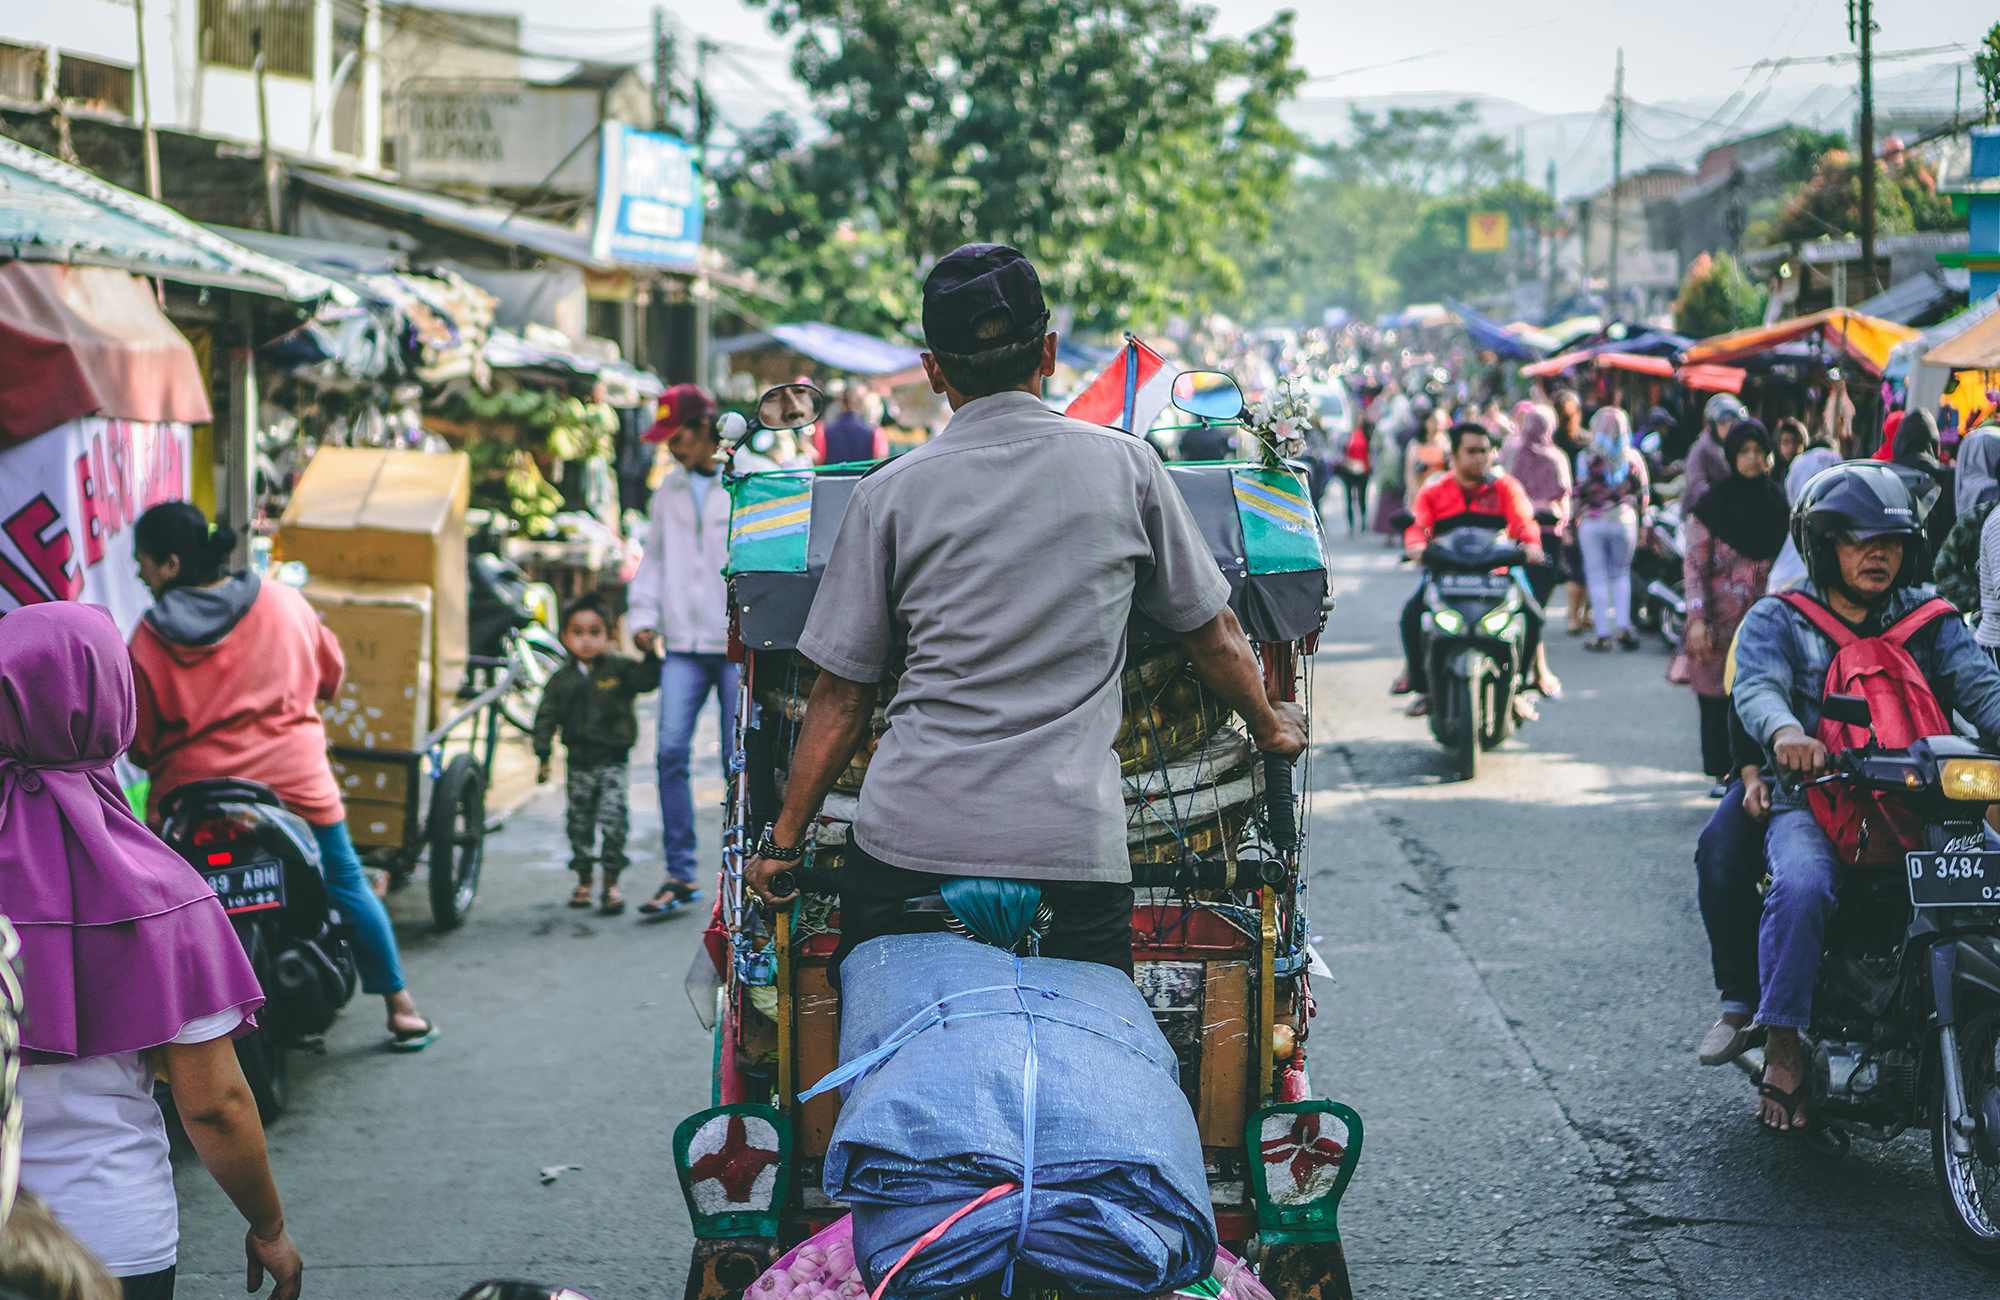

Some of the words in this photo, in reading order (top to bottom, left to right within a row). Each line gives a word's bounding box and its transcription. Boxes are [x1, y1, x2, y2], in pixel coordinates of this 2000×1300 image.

[0, 490, 85, 618] IE
[1910, 857, 1923, 879] D
[1934, 856, 1985, 879] 3484
